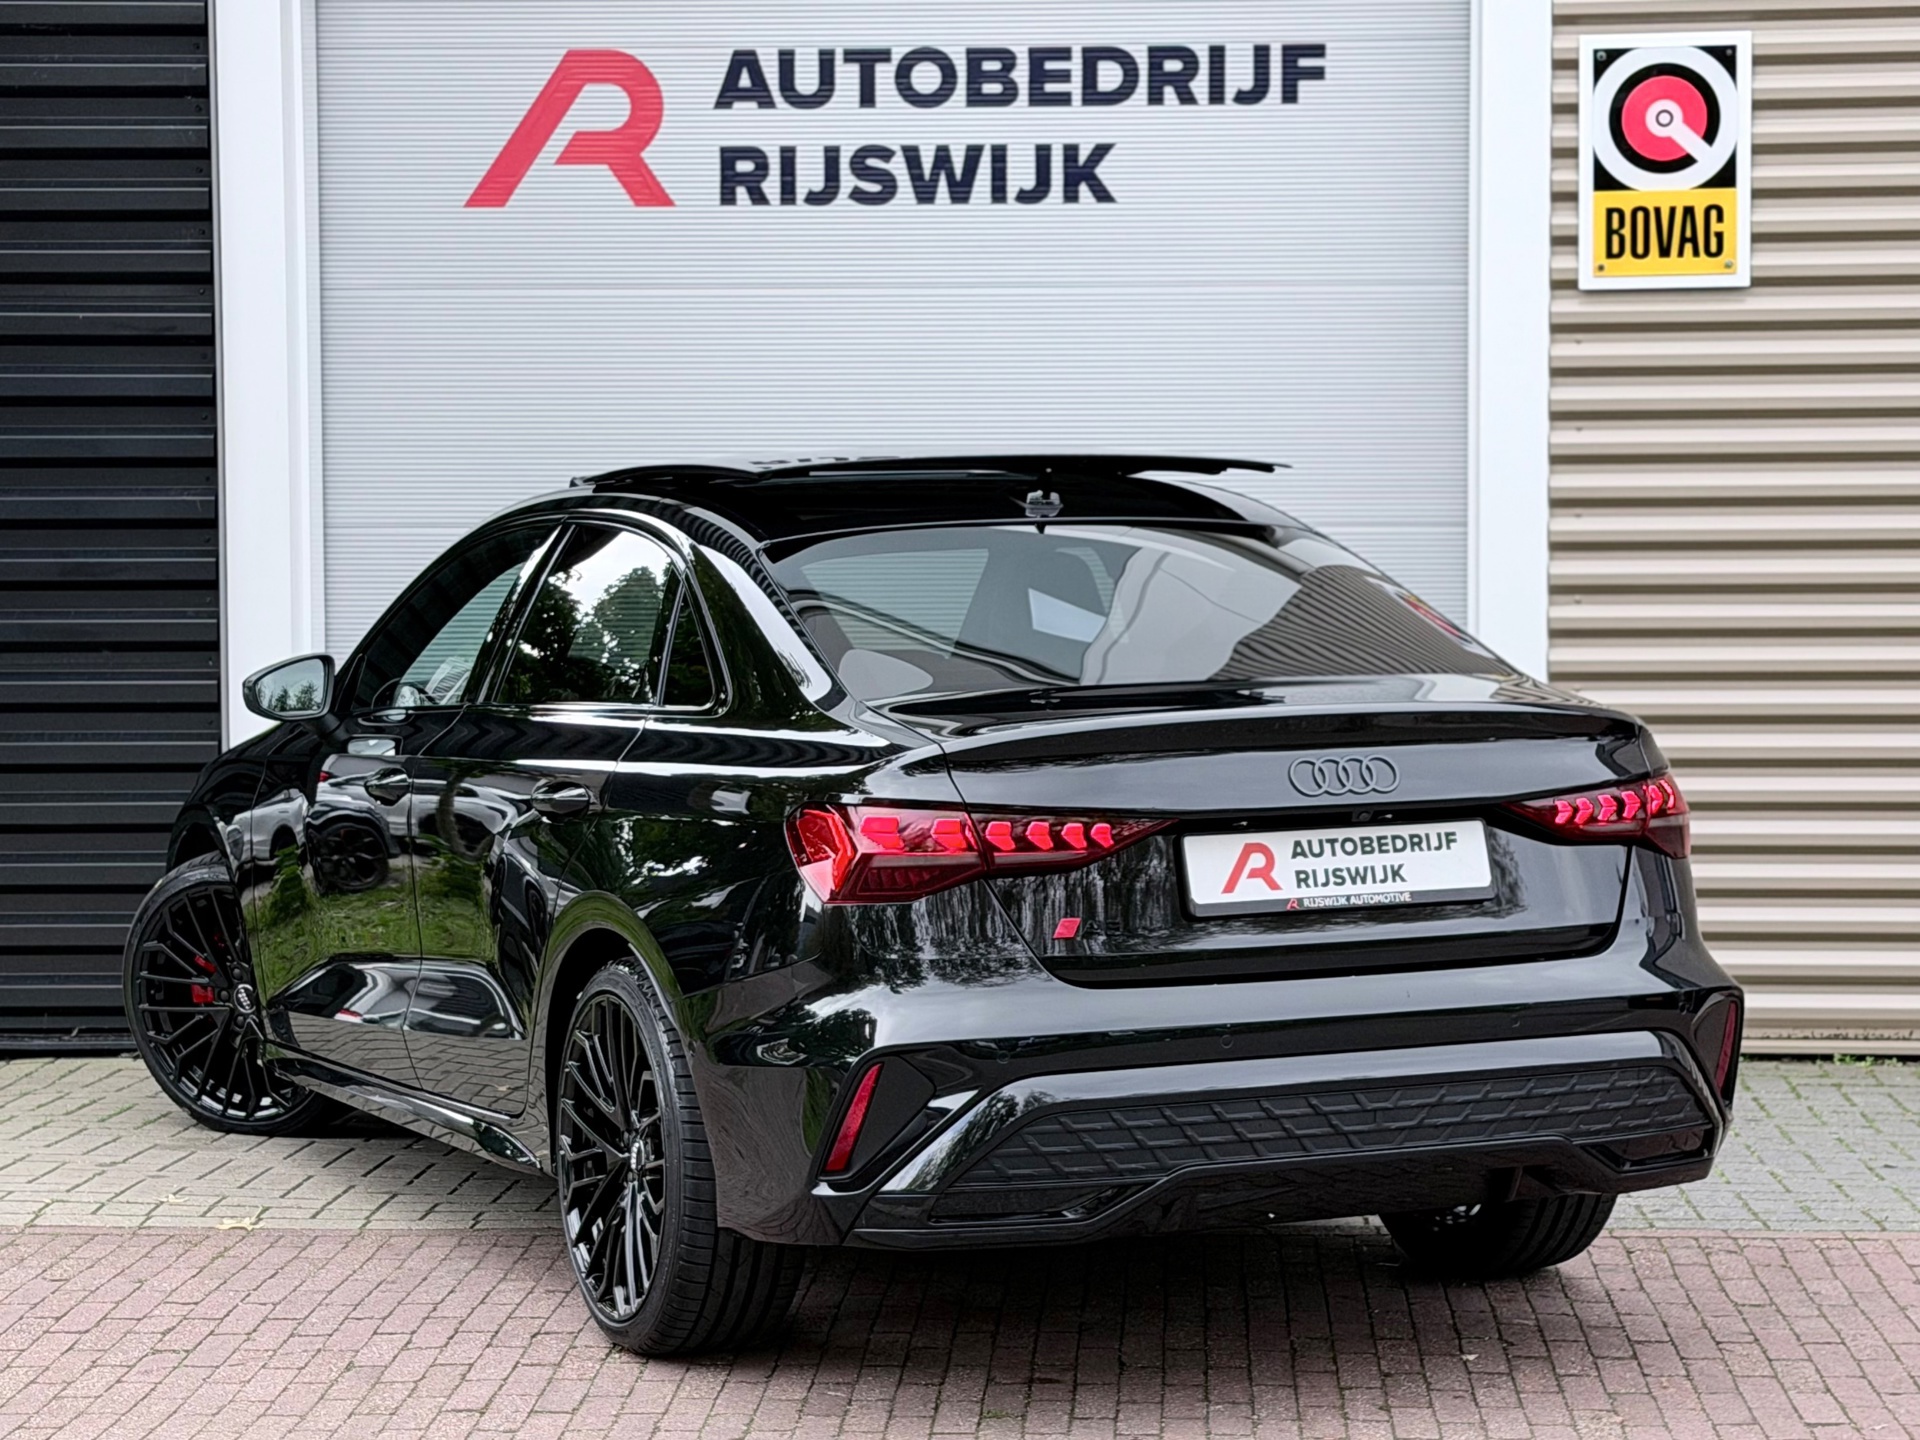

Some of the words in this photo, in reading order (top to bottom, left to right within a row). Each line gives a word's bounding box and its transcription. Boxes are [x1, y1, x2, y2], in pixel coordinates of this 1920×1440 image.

[713, 43, 1327, 110] AUTOBEDRIJF
[718, 142, 1117, 208] RIJSWIJK
[1605, 204, 1725, 260] BOVAG
[1290, 831, 1458, 860] AUTOBEDRIJF
[1294, 863, 1408, 889] RIJSWIJK
[1303, 896, 1348, 908] RIJSWIJK
[1349, 892, 1412, 905] AUTOMOTIVE
